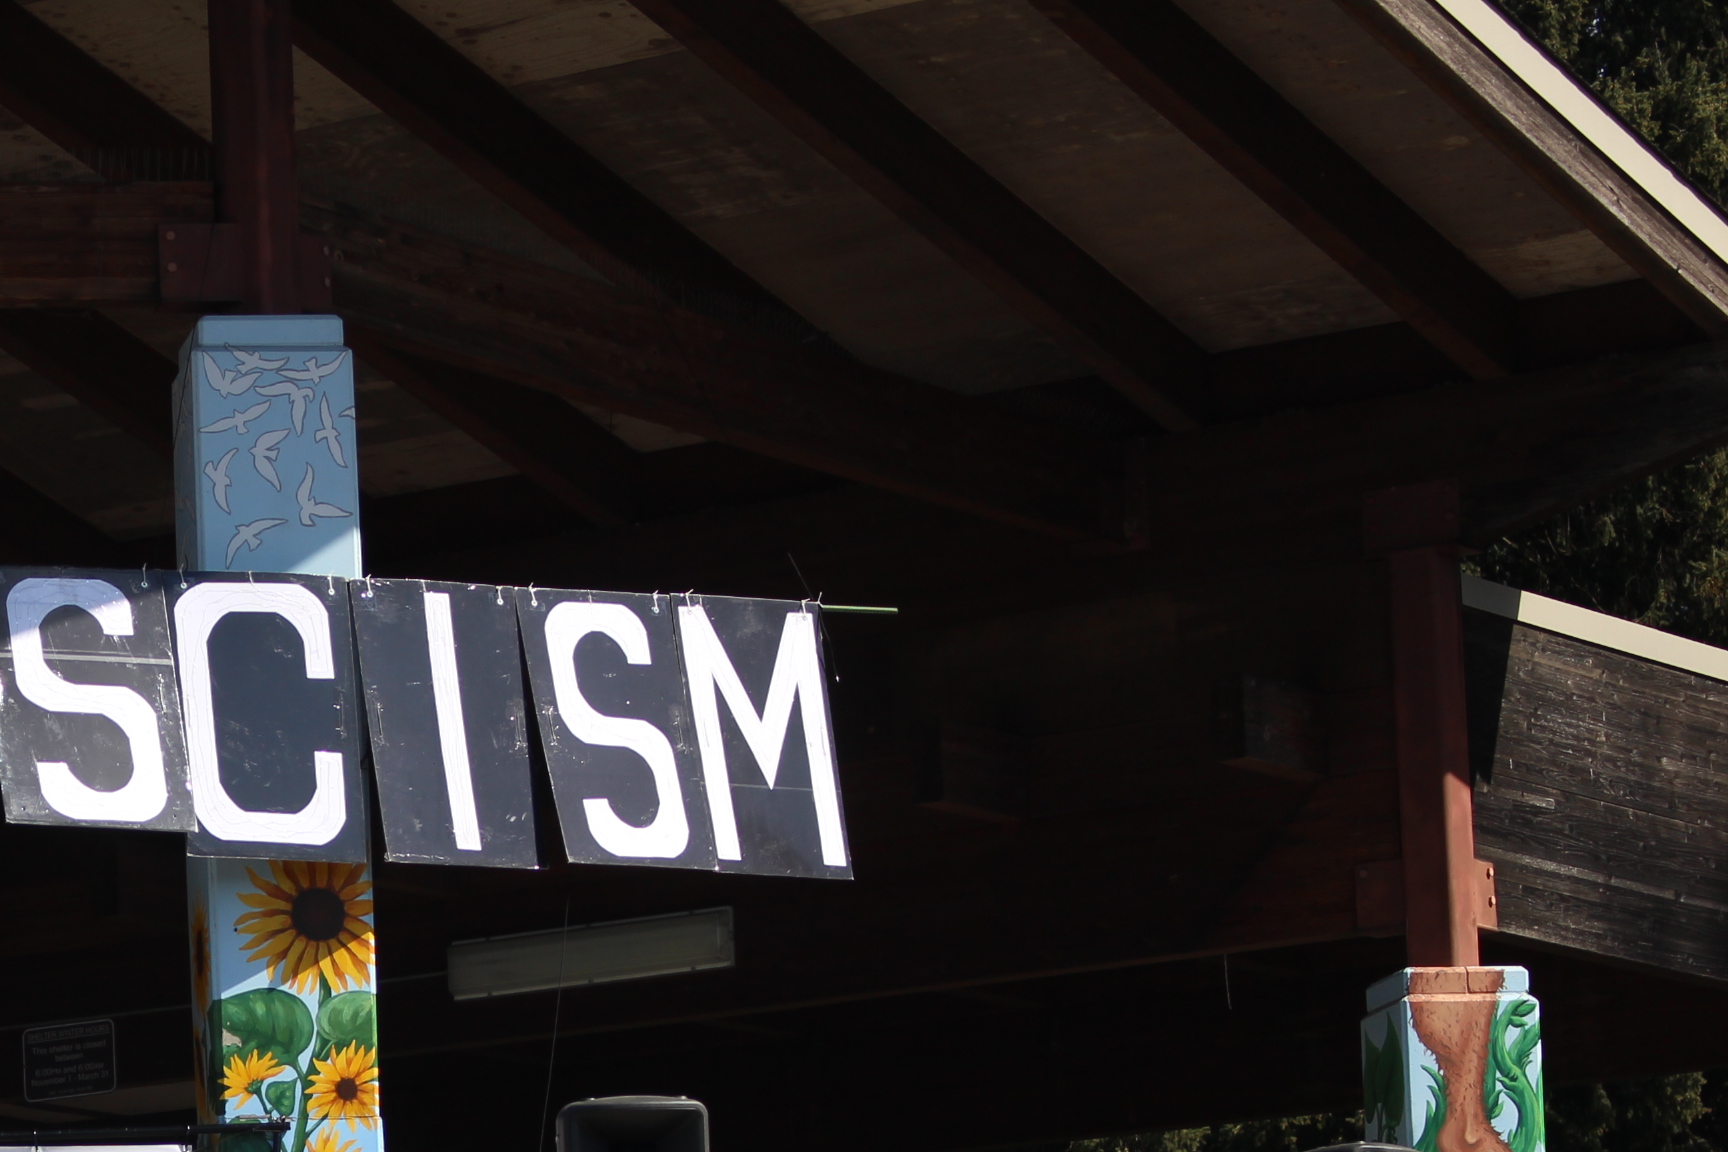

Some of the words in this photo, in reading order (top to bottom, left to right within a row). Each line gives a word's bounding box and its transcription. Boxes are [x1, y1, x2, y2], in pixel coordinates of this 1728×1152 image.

[85, 1024, 110, 1034] HOURS
[32, 1047, 47, 1055] This
[82, 1039, 106, 1049] closed
[54, 1053, 83, 1062] between
[63, 1065, 77, 1074] and
[31, 1077, 66, 1087] November
[78, 1072, 100, 1081] March
